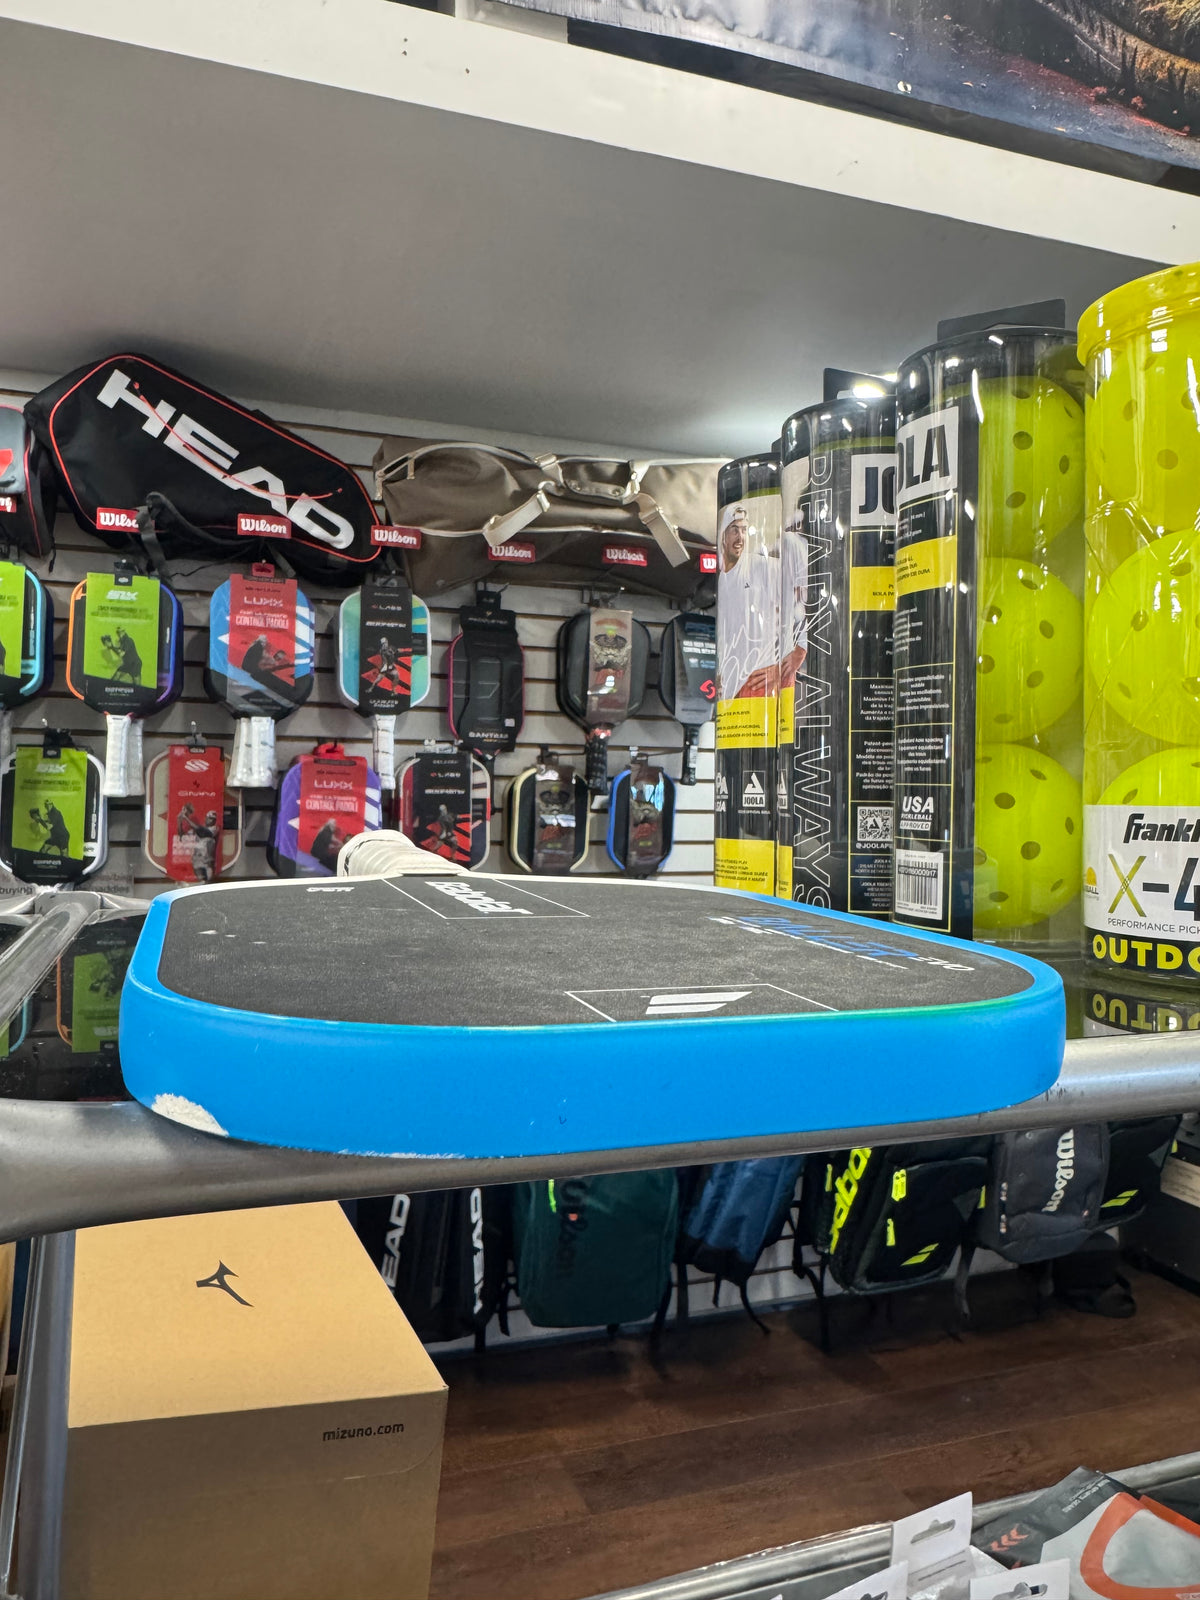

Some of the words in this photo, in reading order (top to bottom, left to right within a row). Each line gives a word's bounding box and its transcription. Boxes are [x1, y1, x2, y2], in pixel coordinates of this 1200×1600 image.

[97, 369, 355, 549] HEAD
[241, 518, 287, 535] Wilson
[374, 529, 417, 546] Wilson
[491, 545, 532, 560] Wilson
[606, 548, 645, 563] Wilson
[743, 795, 764, 806] JOOLA
[902, 796, 935, 813] USA
[1108, 854, 1200, 922] X-4
[1107, 917, 1176, 933] PERFORMANCE
[1040, 1128, 1075, 1213] Wilson
[381, 1193, 410, 1288] EAD
[322, 1423, 405, 1441] mizuno.com
